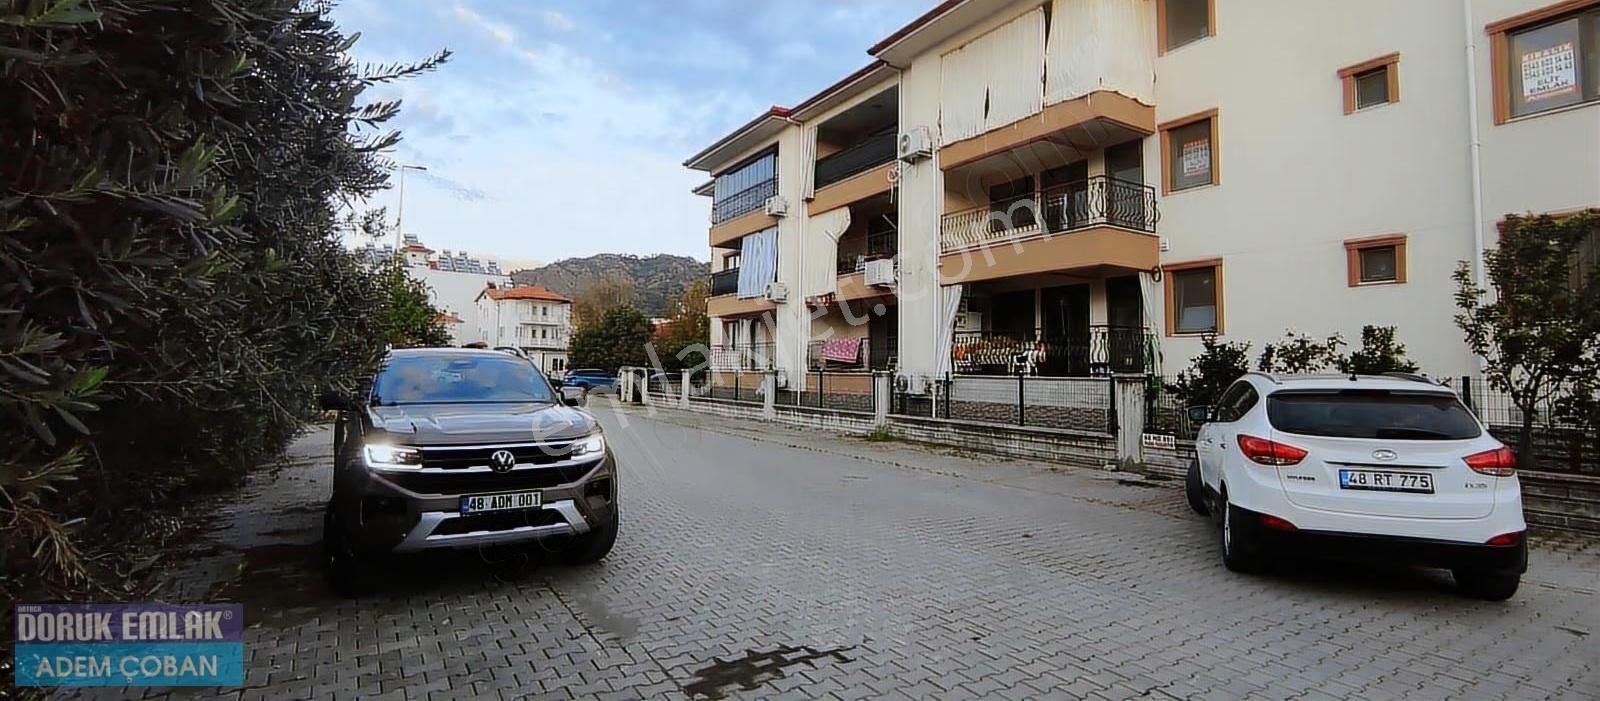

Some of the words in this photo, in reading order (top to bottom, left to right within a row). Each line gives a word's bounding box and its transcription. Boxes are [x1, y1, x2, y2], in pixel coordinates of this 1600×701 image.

[1349, 473, 1367, 485] 48
[1374, 473, 1393, 486] RT
[1400, 475, 1429, 488] 775
[470, 497, 485, 511] 48
[518, 493, 539, 507] 001
